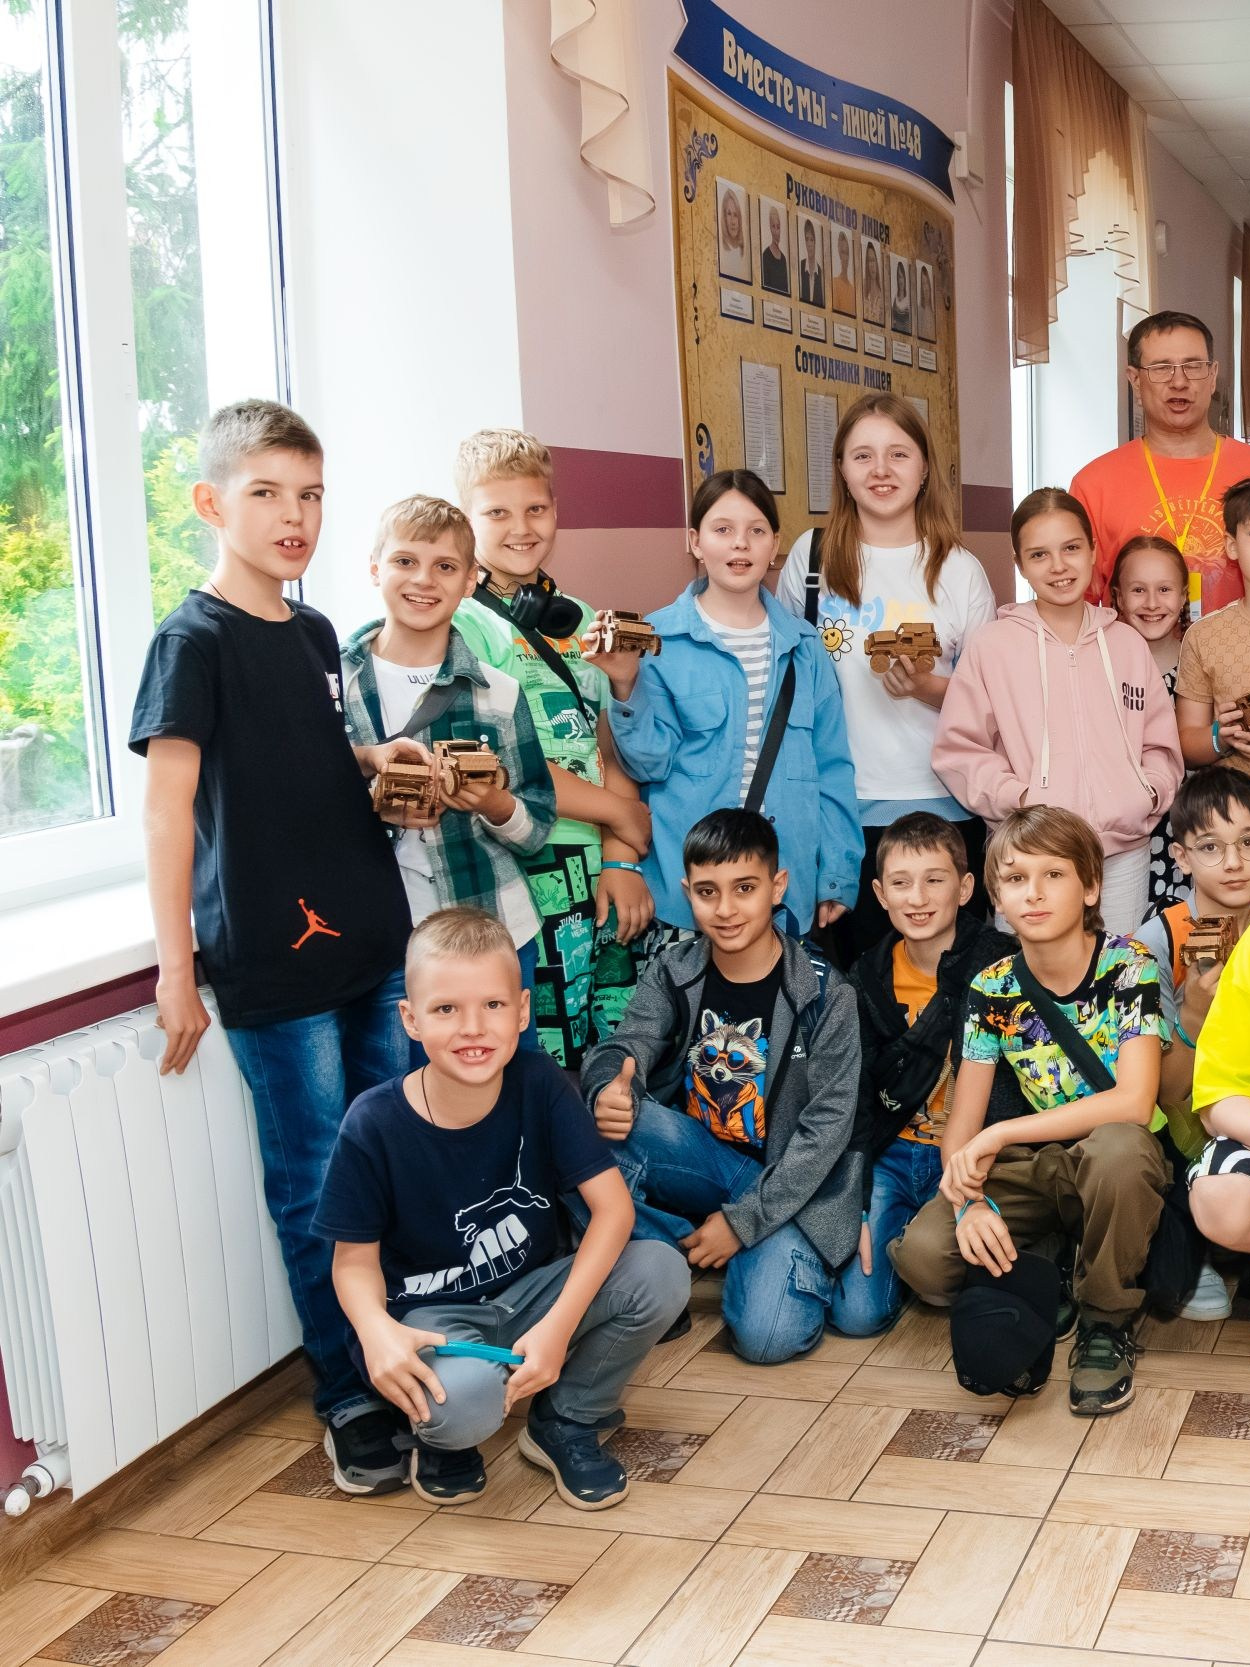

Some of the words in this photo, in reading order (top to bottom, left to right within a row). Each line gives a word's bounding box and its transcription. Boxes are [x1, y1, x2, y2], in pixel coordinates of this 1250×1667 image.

[723, 27, 794, 113] Вместе
[796, 86, 827, 129] мы
[842, 103, 886, 147] лицей
[889, 112, 921, 161] №48
[786, 172, 858, 231] Руководство
[861, 213, 890, 245] лицея
[795, 344, 860, 385] Сотрудники
[863, 366, 892, 392] лицея
